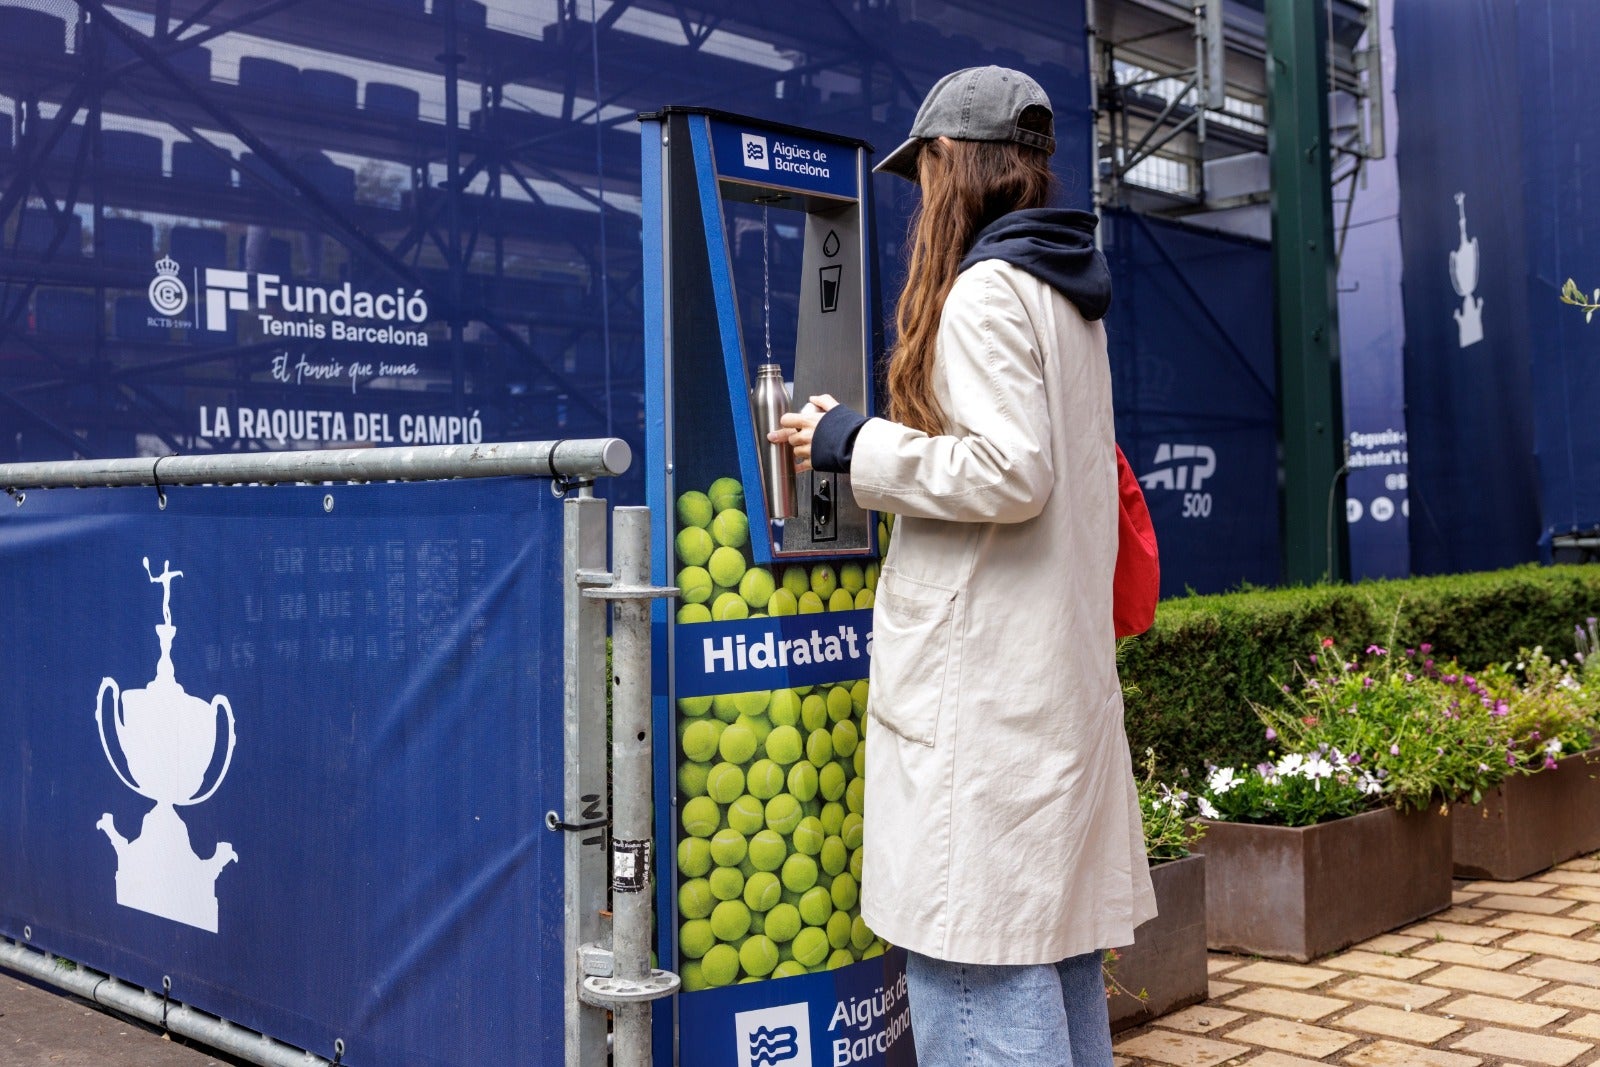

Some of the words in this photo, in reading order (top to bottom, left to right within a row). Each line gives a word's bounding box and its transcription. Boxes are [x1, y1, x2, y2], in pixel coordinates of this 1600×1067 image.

[774, 141, 811, 160] Aigües
[813, 149, 827, 163] de
[775, 157, 830, 178] Barcelona
[257, 273, 428, 322] Fundació
[258, 314, 326, 339] Tennis
[331, 320, 428, 347] Barcelona
[272, 352, 291, 383] El
[295, 353, 343, 385] tennis
[348, 361, 373, 394] que
[378, 361, 419, 376] suma
[200, 406, 231, 438] LA
[238, 408, 348, 444] RAQUETA
[354, 413, 394, 442] DEL
[399, 410, 483, 444] CAMPIÓ
[1138, 443, 1217, 491] ATP
[1182, 492, 1213, 518] 500
[703, 625, 860, 674] Hidrata't
[827, 987, 895, 1031] Aigües
[897, 971, 907, 997] de
[832, 1006, 911, 1067] Barcelona
